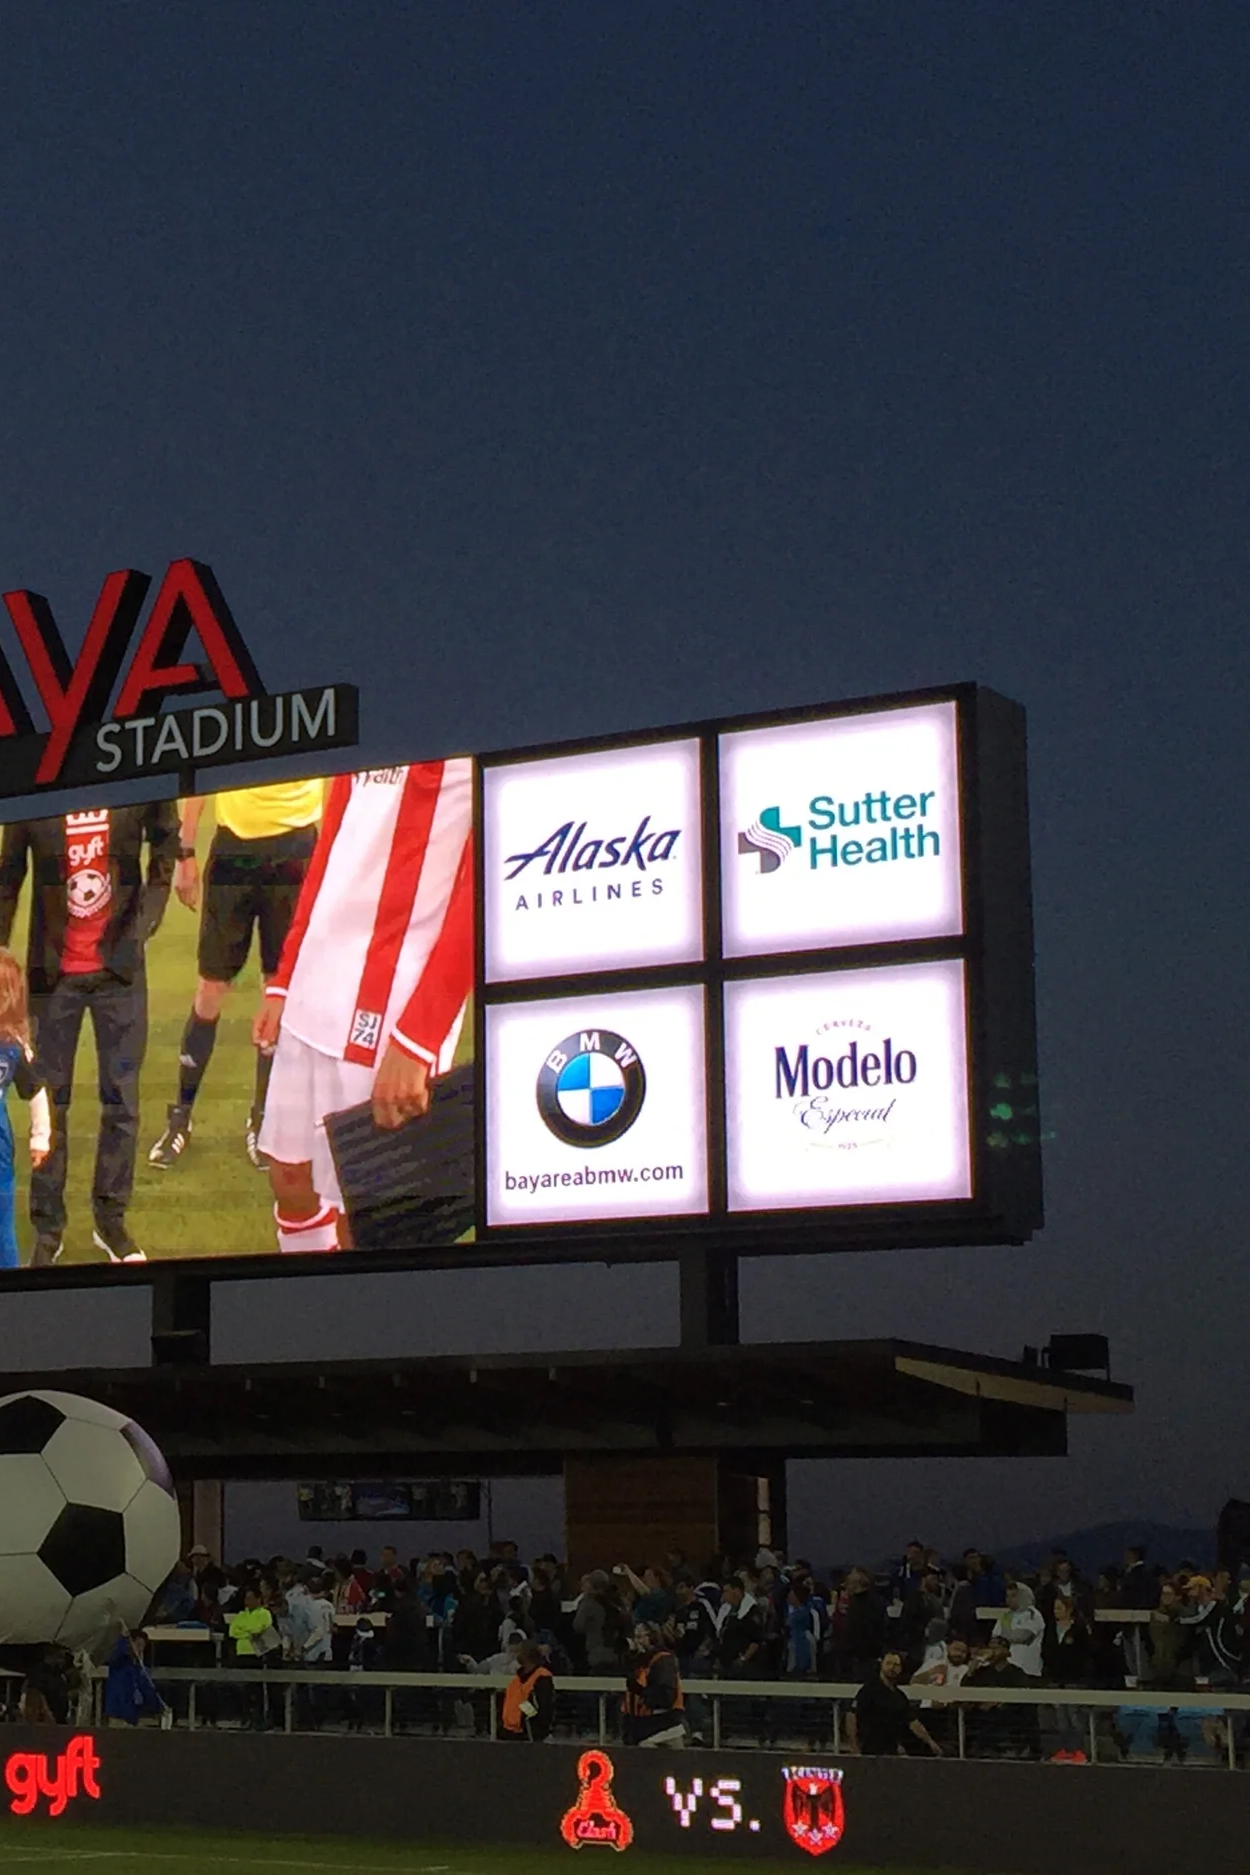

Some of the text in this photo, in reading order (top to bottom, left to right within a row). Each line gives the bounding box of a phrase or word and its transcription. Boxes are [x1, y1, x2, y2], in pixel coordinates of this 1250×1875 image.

[95, 688, 336, 773] STADIUM
[808, 790, 936, 830] Sutter
[68, 835, 105, 866] gyft
[503, 815, 682, 881] Alaska
[810, 824, 940, 870] Health
[515, 878, 664, 911] AIRLINES
[353, 1028, 375, 1046] 74
[358, 1013, 378, 1030] SJ
[546, 1031, 638, 1073] BMW
[774, 1037, 917, 1099] Modelo
[505, 1165, 684, 1194] bayareabmw.com
[5, 1735, 101, 1816] gyft
